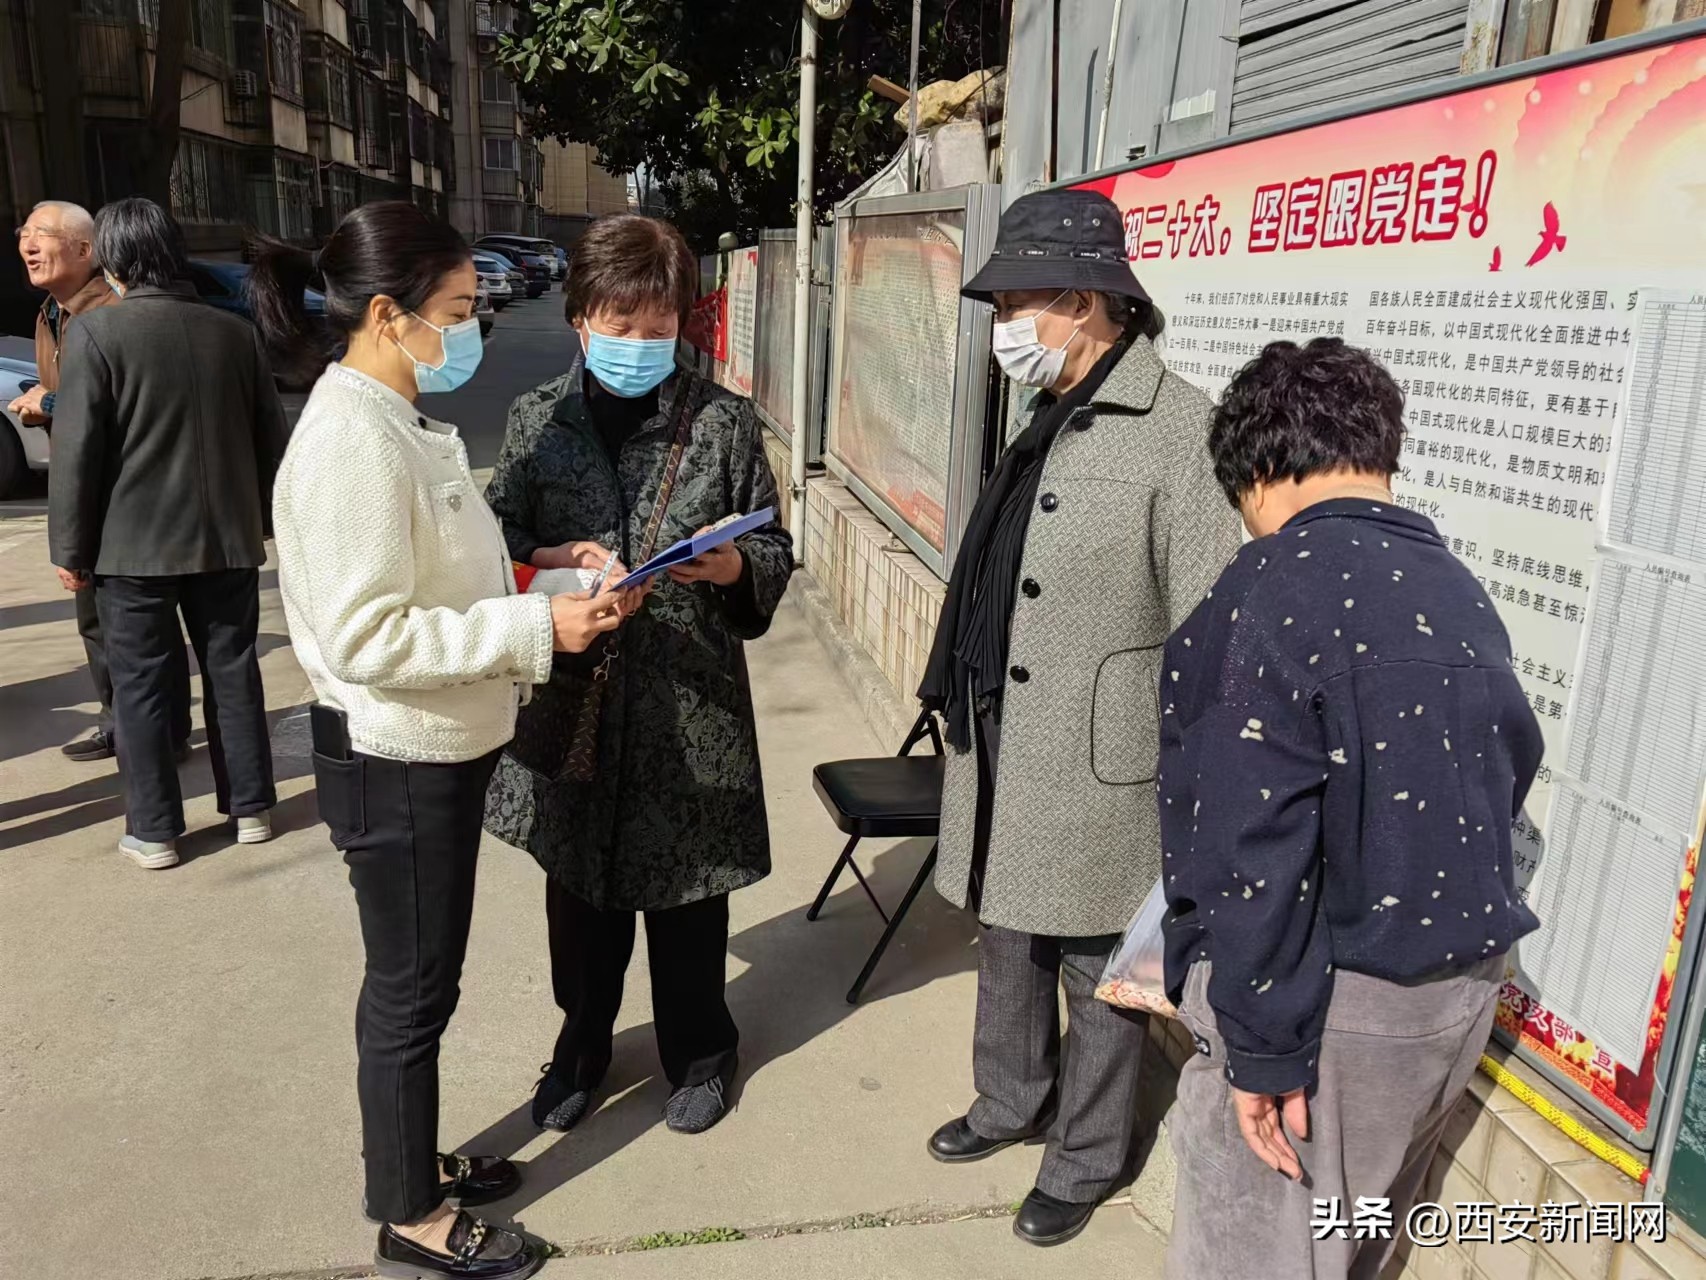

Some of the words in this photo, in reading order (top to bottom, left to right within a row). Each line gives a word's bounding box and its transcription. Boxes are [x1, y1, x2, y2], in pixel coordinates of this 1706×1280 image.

[1392, 378, 1617, 419] 各国现代化的共同特征，更有基于
[1400, 437, 1606, 486] 同富裕的现代化，是物质文明和
[1392, 493, 1446, 519] 的现代化。
[1395, 465, 1599, 522] 化，是人与自然和谐共生的现代
[1512, 652, 1575, 689] 会主义
